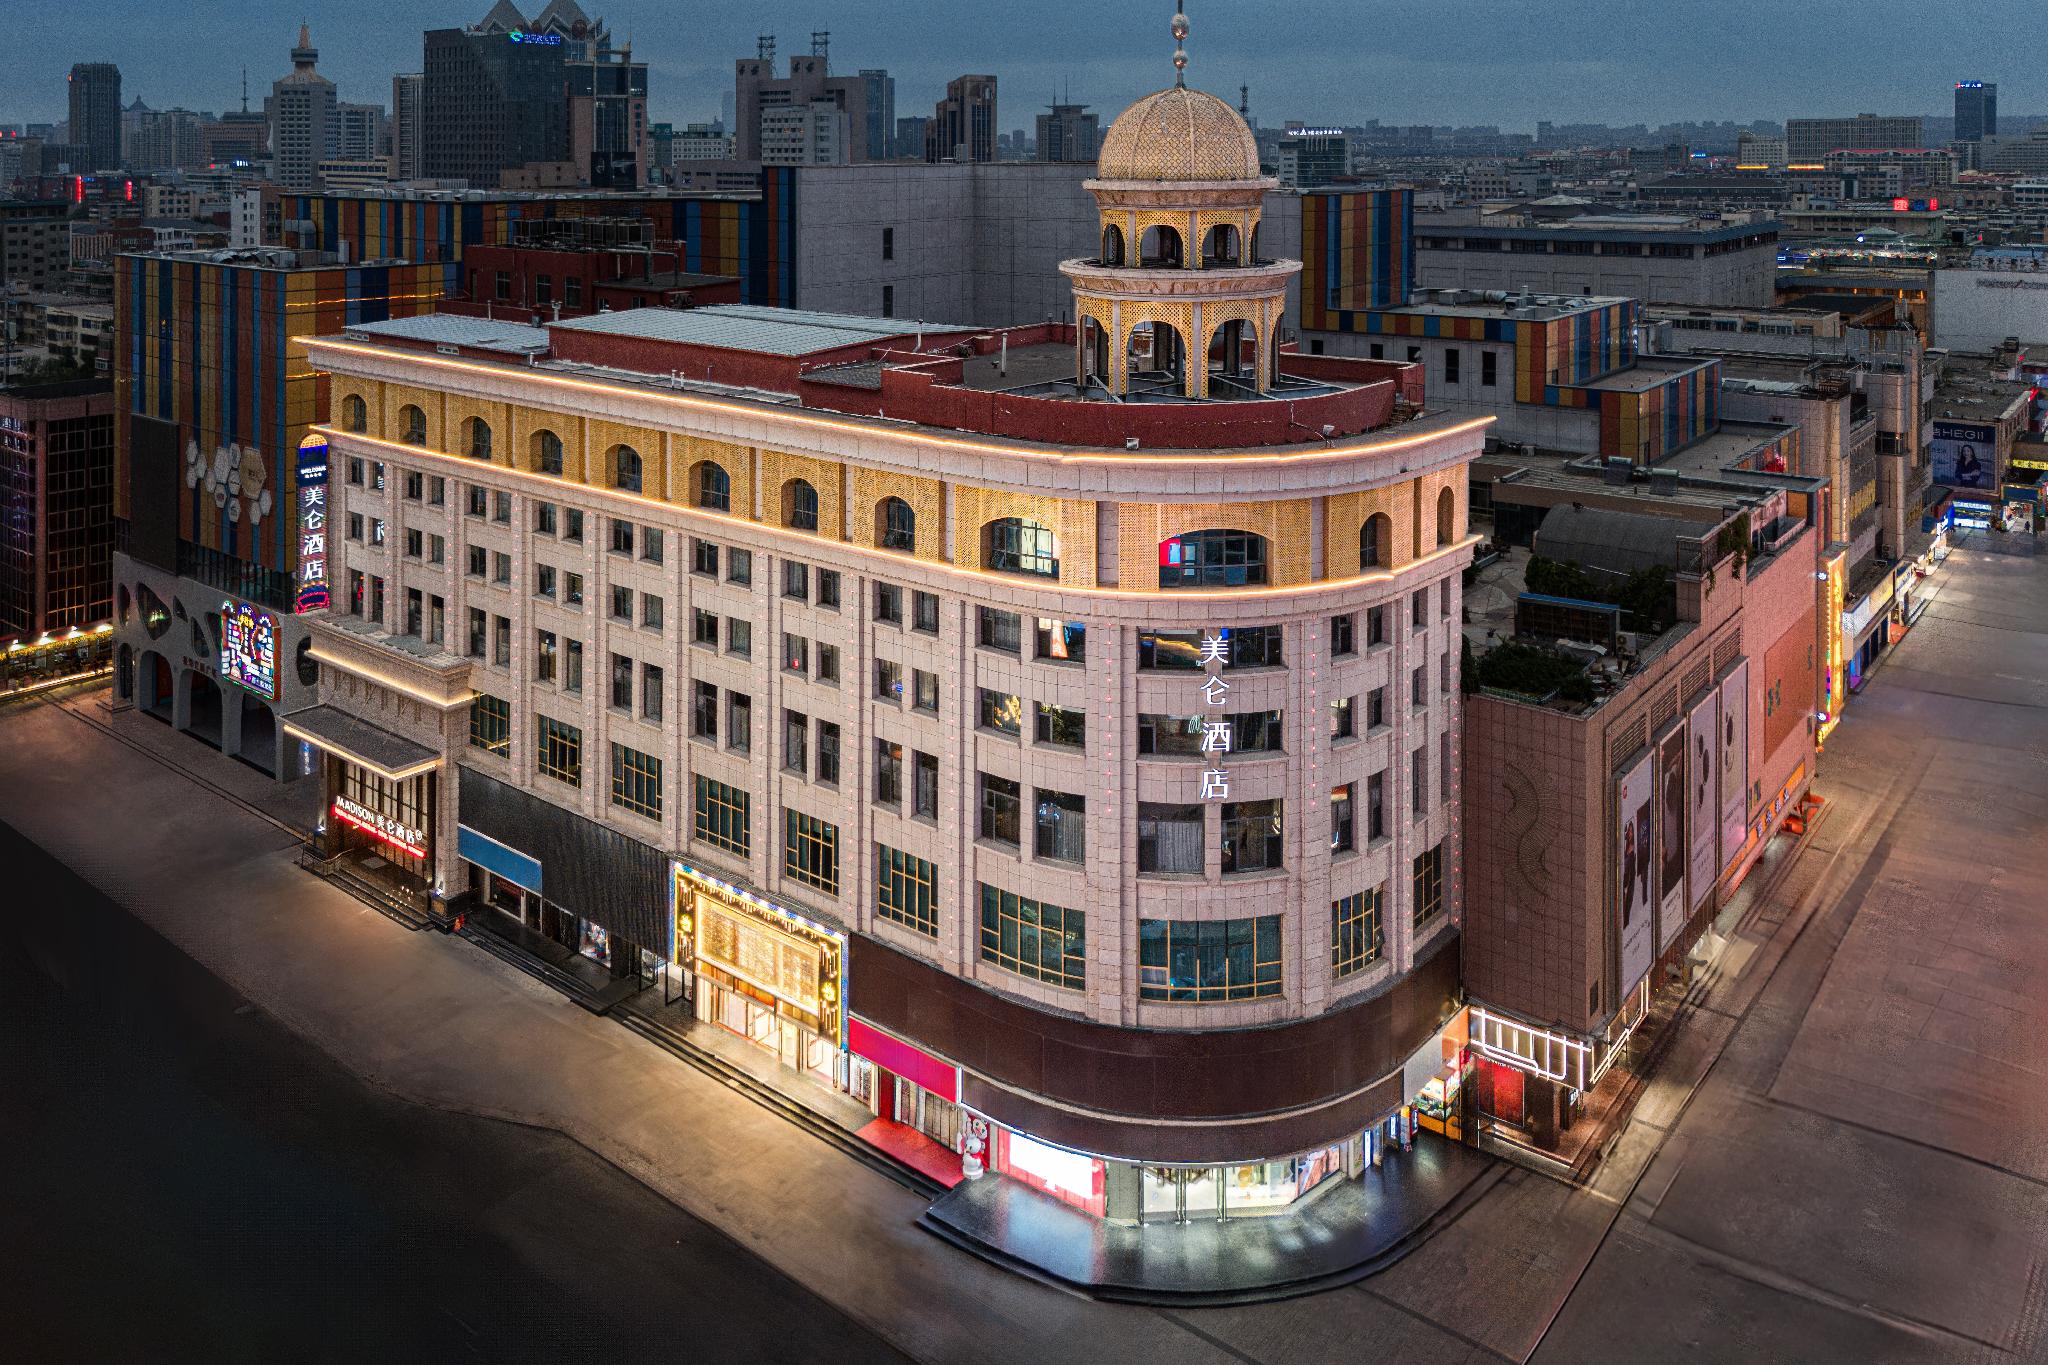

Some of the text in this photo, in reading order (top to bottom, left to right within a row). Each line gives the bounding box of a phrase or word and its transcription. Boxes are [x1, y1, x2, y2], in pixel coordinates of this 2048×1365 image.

[304, 486, 324, 582] 美仑酒店
[1200, 635, 1231, 799] 美仑酒店
[336, 795, 375, 824] MADISON
[377, 814, 415, 845] 美仑酒店
